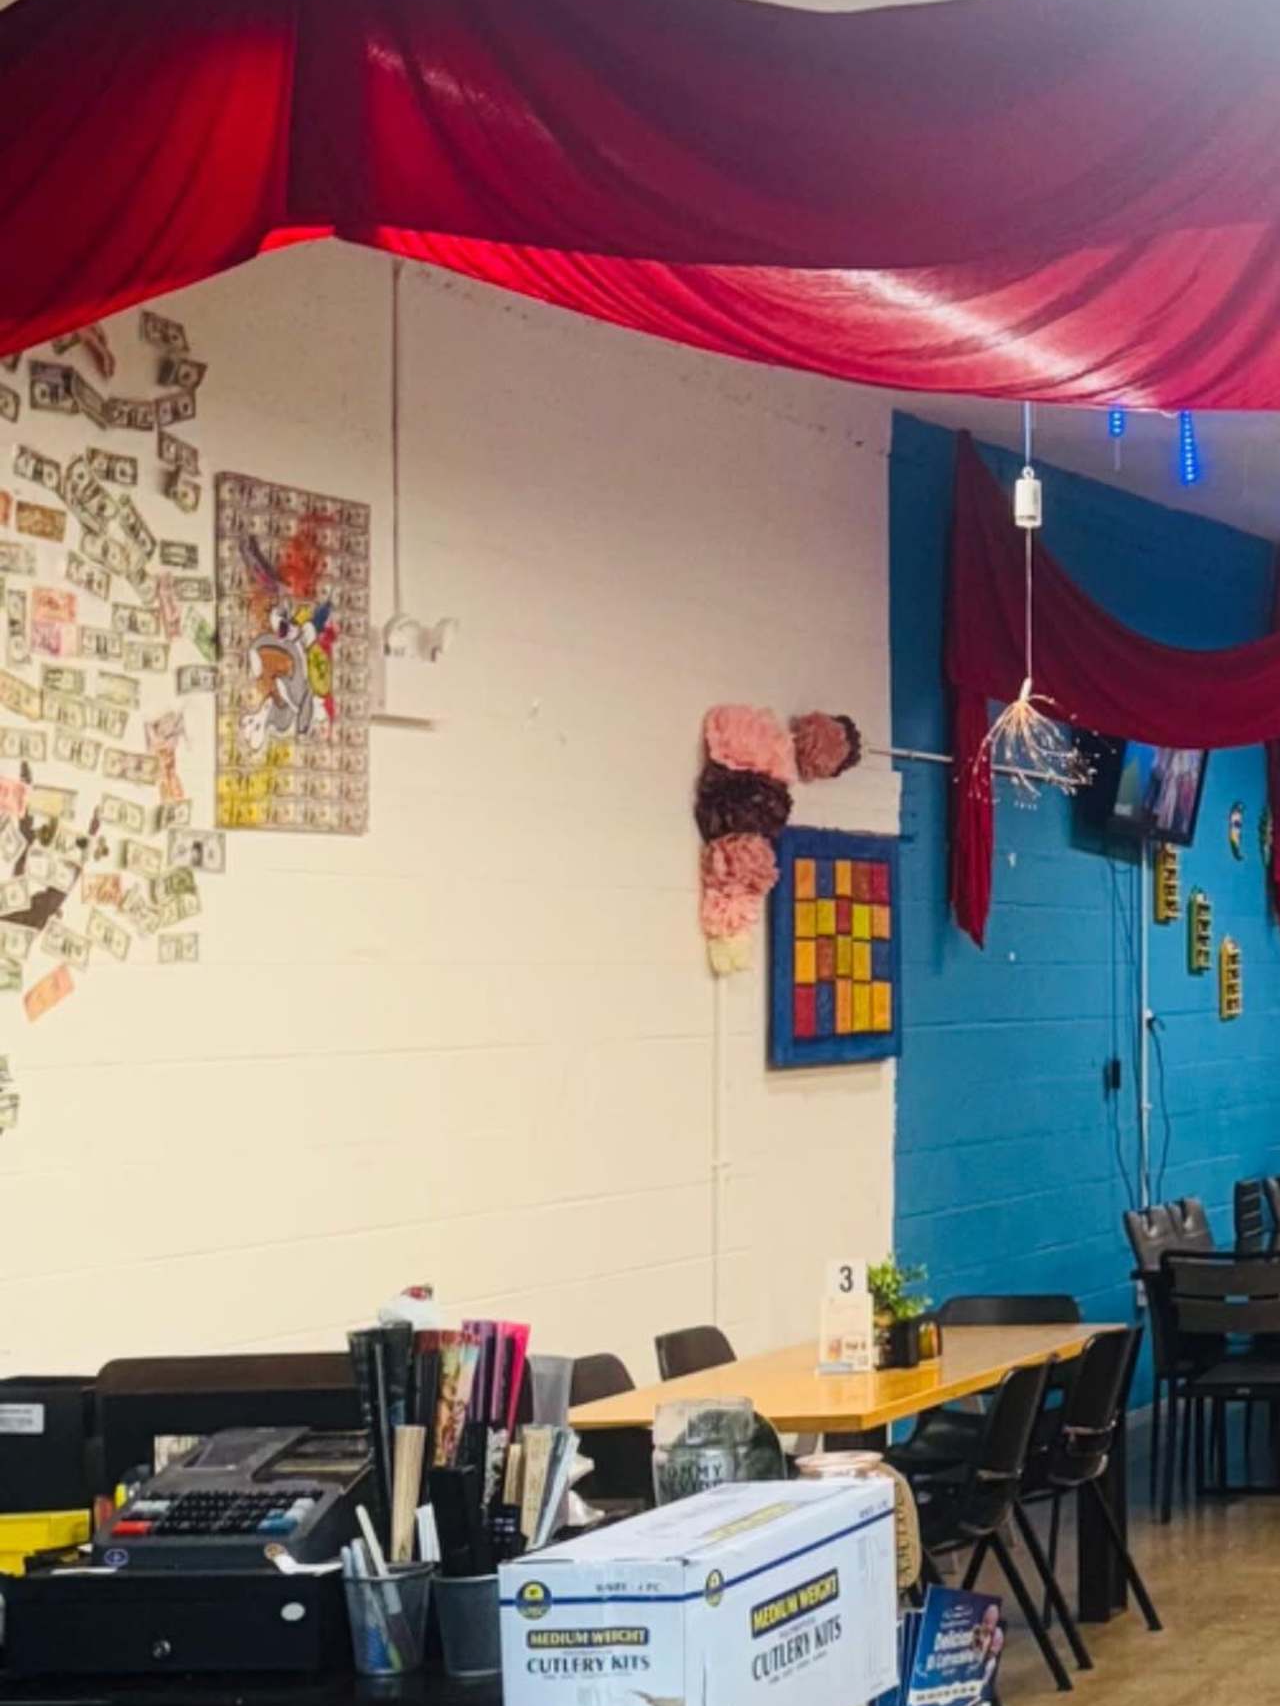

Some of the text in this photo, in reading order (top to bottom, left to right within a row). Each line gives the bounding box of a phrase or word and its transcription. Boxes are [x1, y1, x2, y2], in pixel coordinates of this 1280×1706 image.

[839, 1266, 854, 1293] 3
[754, 1593, 798, 1628] MEDIUM
[799, 1574, 837, 1611] WEIGHT
[530, 1629, 646, 1644] MEDIUM WEIGHT
[752, 1631, 811, 1681] CUTLERY
[815, 1615, 843, 1648] KITS
[526, 1654, 650, 1674] CUTLERY KITS
